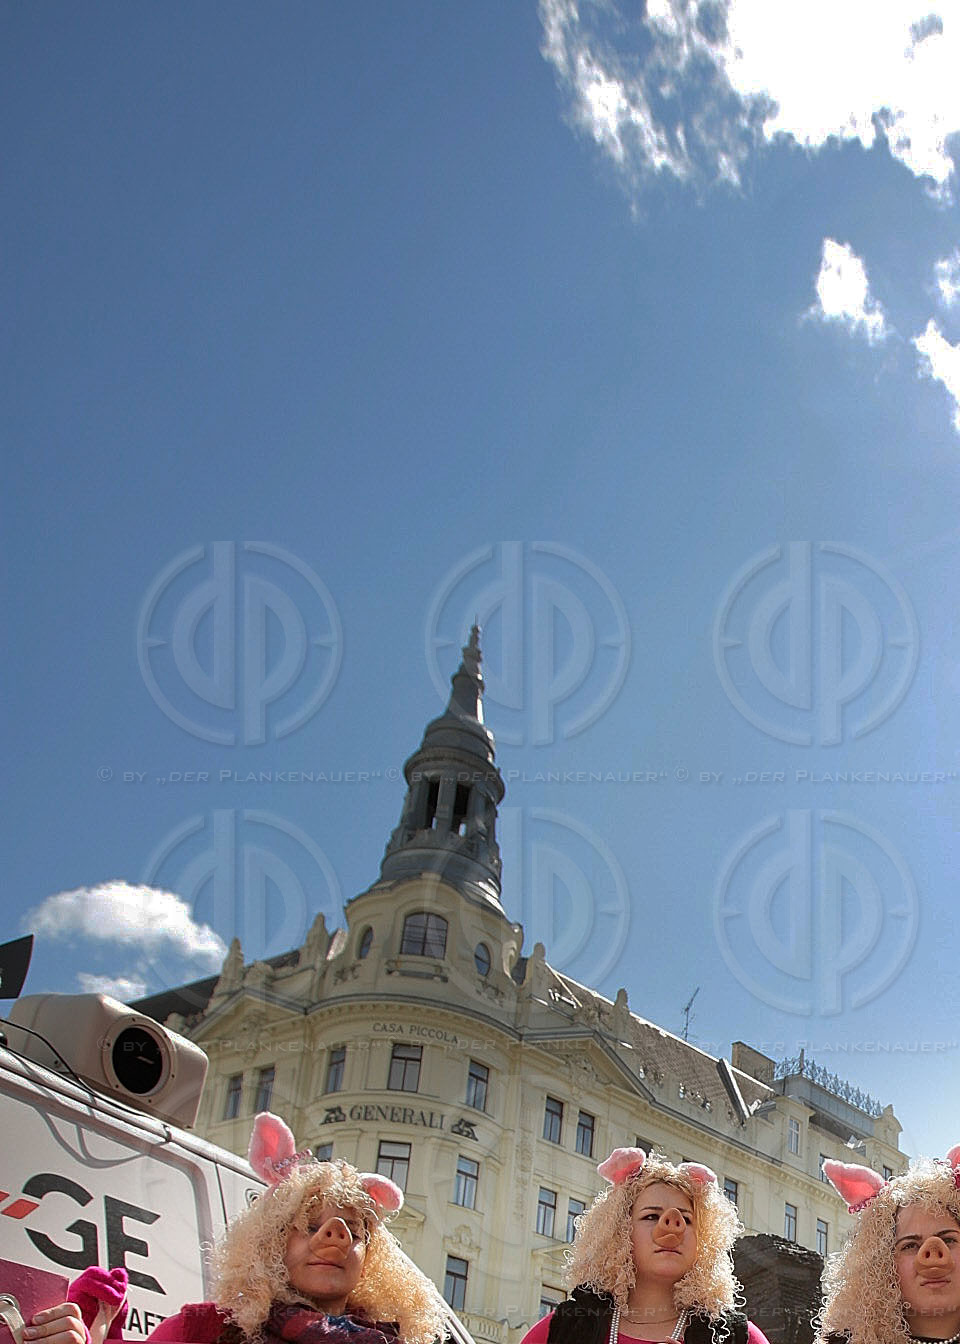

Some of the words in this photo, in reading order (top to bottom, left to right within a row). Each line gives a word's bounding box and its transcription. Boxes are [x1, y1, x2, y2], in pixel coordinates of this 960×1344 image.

[372, 1022, 404, 1034] CASA
[409, 1024, 458, 1044] PICCOLA
[349, 1104, 445, 1130] GENERALI
